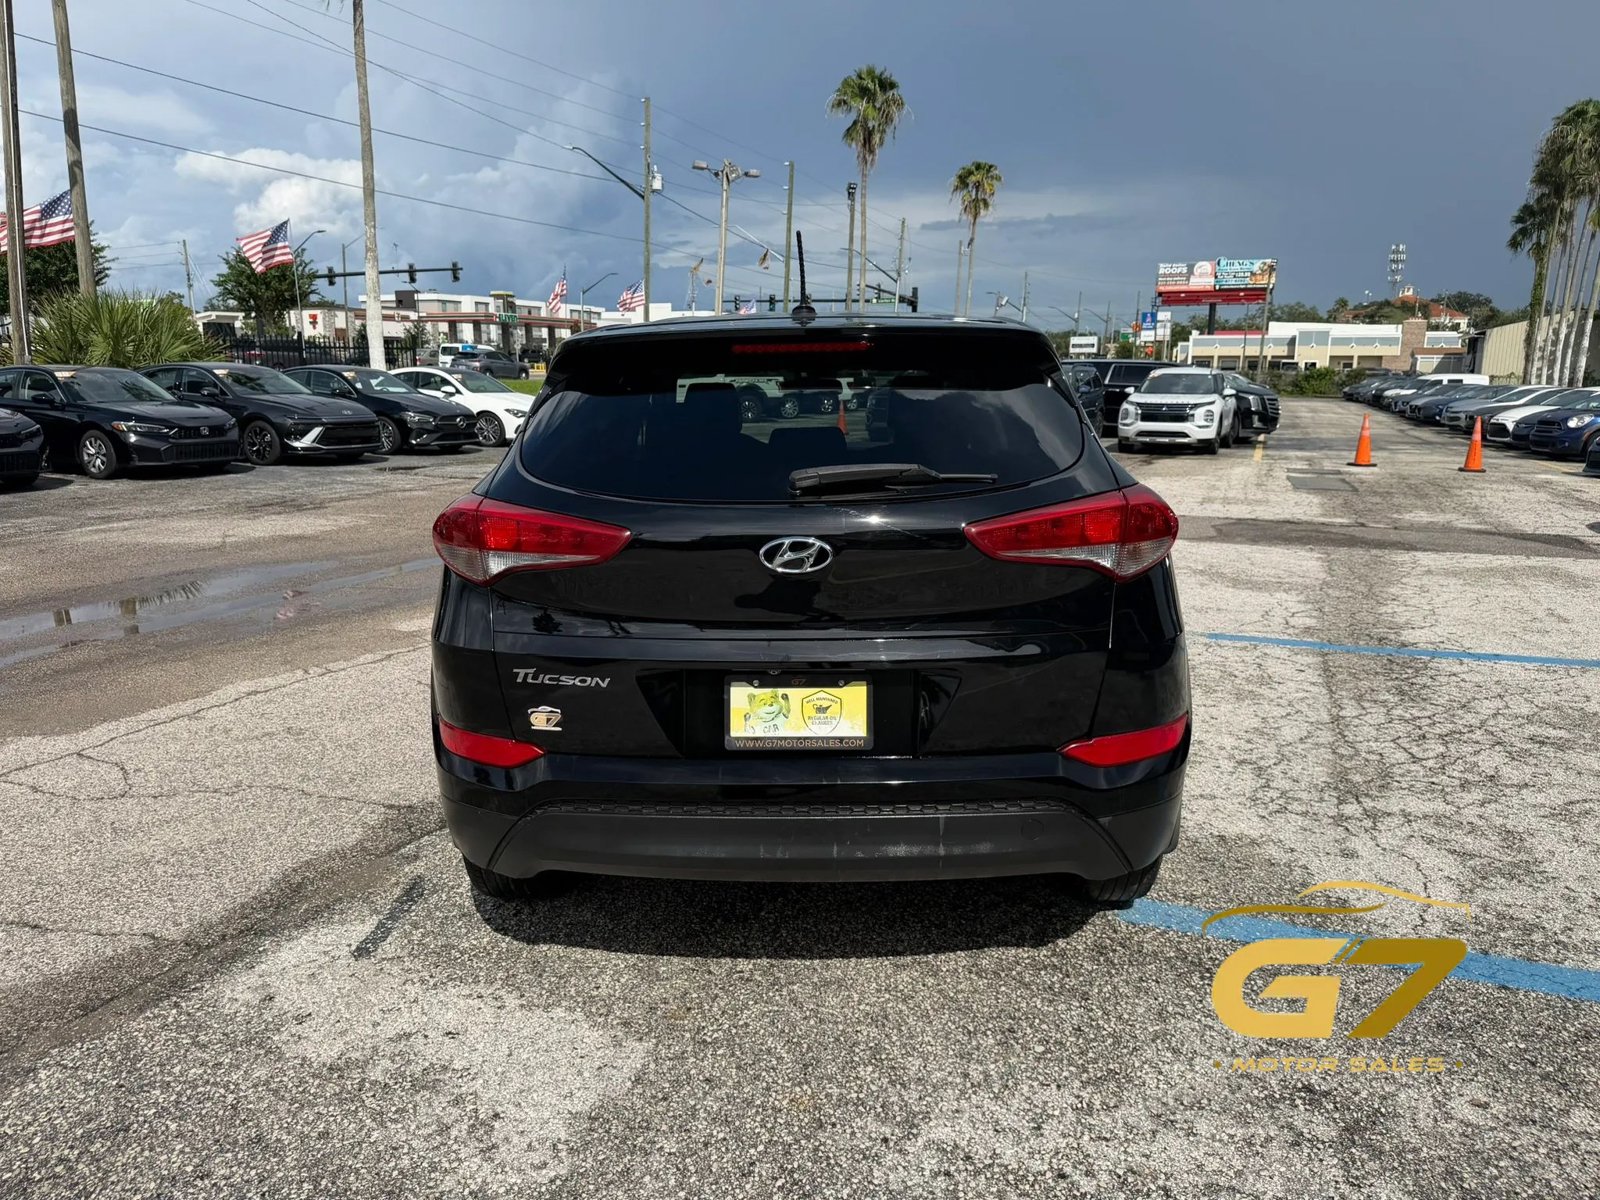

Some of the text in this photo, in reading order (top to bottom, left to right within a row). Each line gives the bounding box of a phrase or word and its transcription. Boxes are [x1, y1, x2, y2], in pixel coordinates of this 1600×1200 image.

[1158, 266, 1188, 274] ROOFS
[513, 668, 610, 688] TUCSON
[735, 739, 864, 748] WWW.G7MOTORSALES.COM
